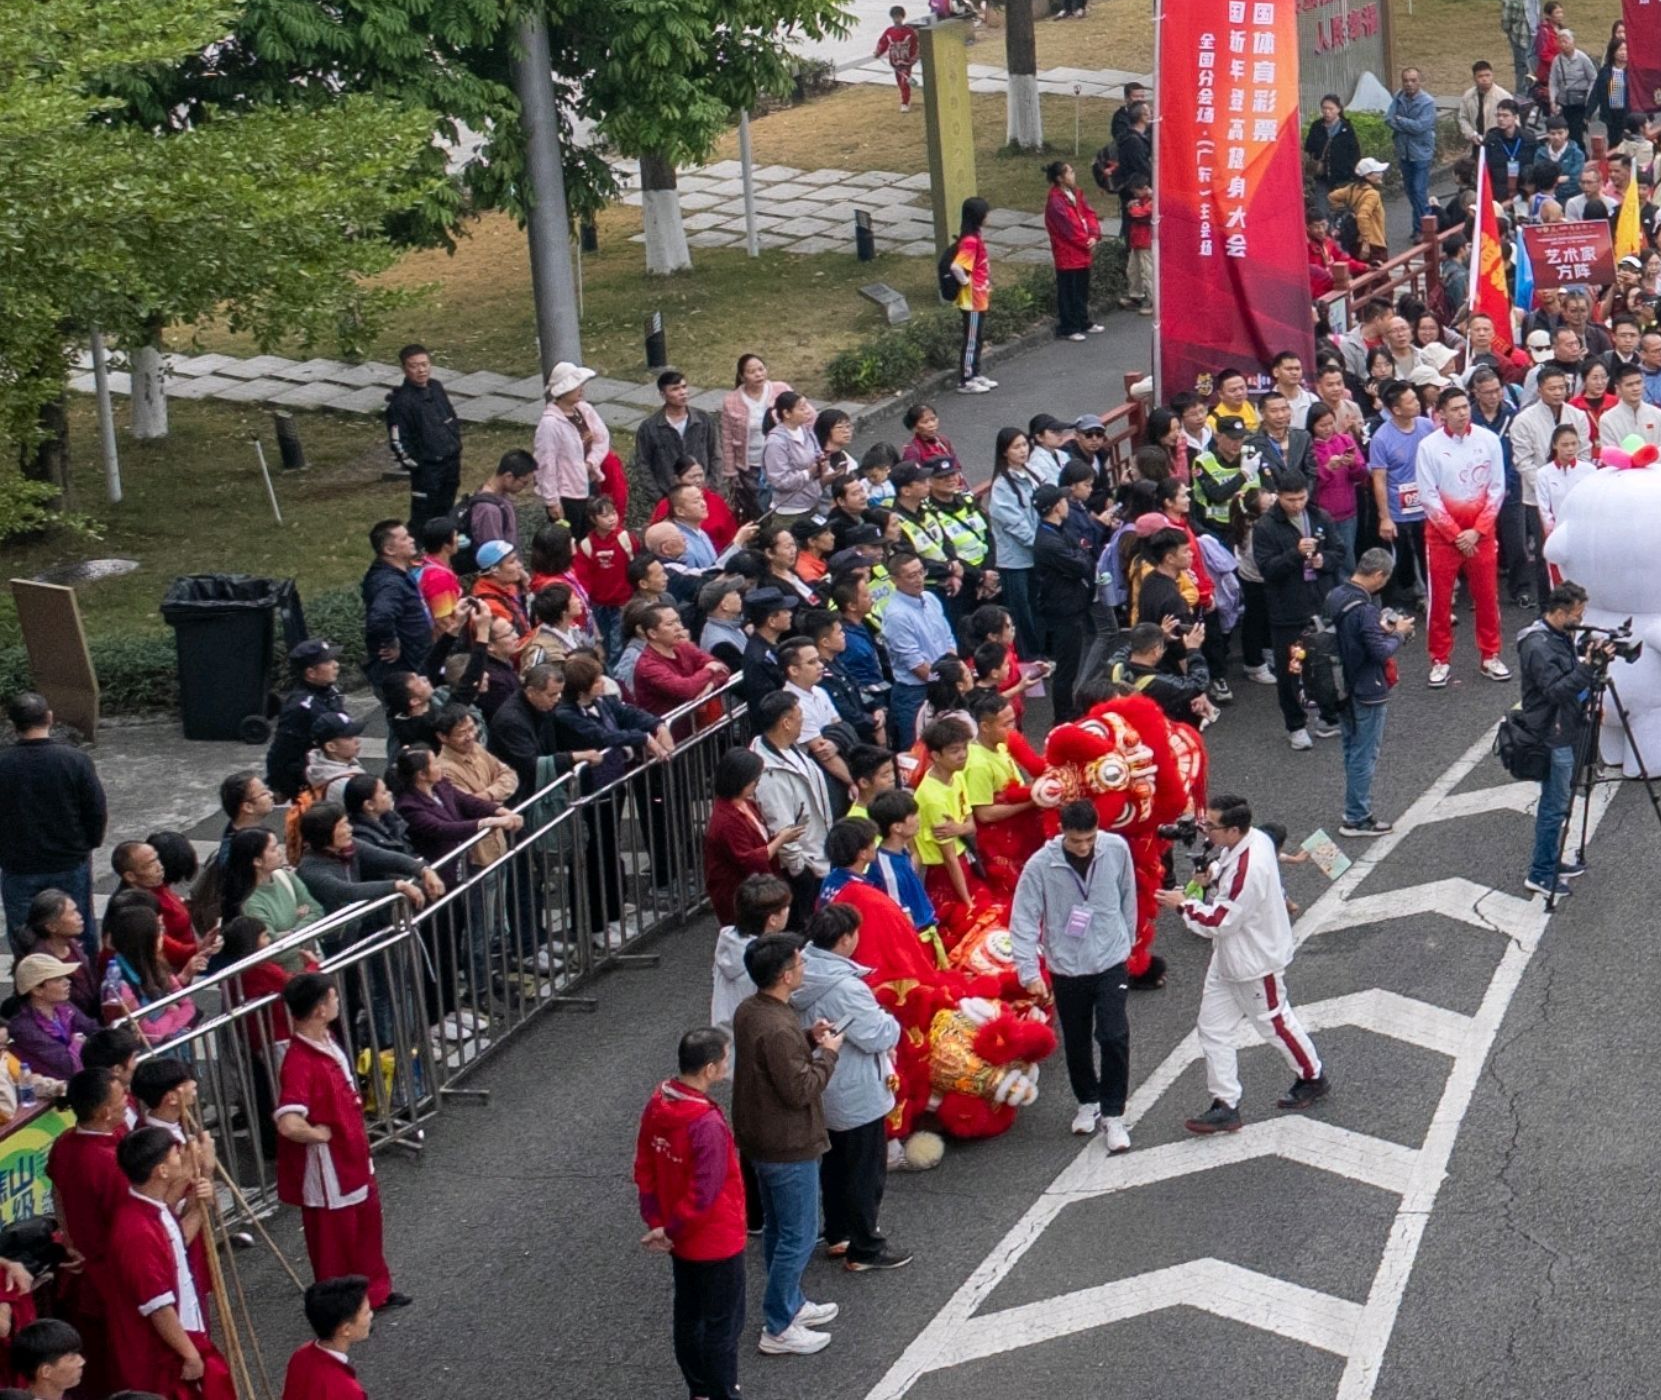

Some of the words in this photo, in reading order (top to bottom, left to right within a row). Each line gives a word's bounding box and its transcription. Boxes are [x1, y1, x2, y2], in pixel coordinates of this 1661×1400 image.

[1544, 245, 1597, 265] 艺术家
[1557, 262, 1592, 280] 方阵
